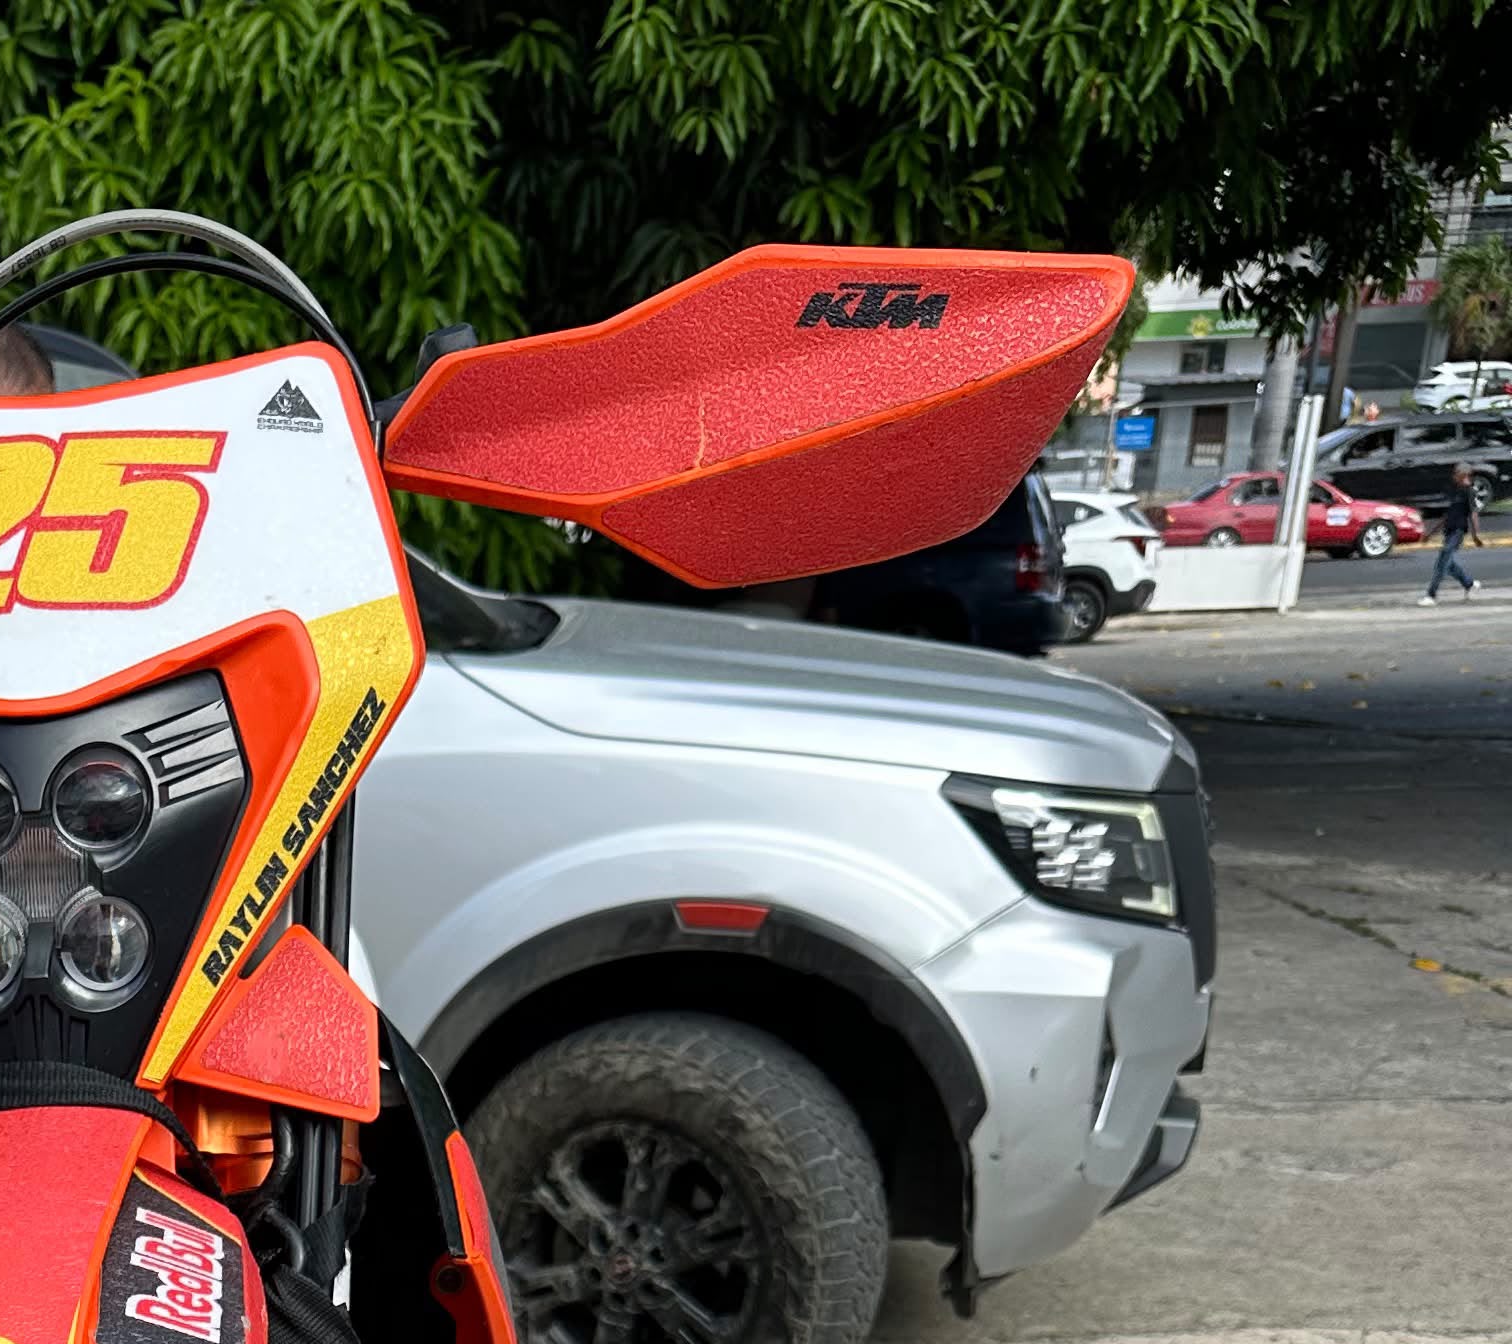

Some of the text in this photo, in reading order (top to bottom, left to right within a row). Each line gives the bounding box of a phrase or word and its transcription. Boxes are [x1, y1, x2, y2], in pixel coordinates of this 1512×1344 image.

[795, 282, 951, 329] KTM
[201, 686, 386, 987] RAYLIN SANCHEZ
